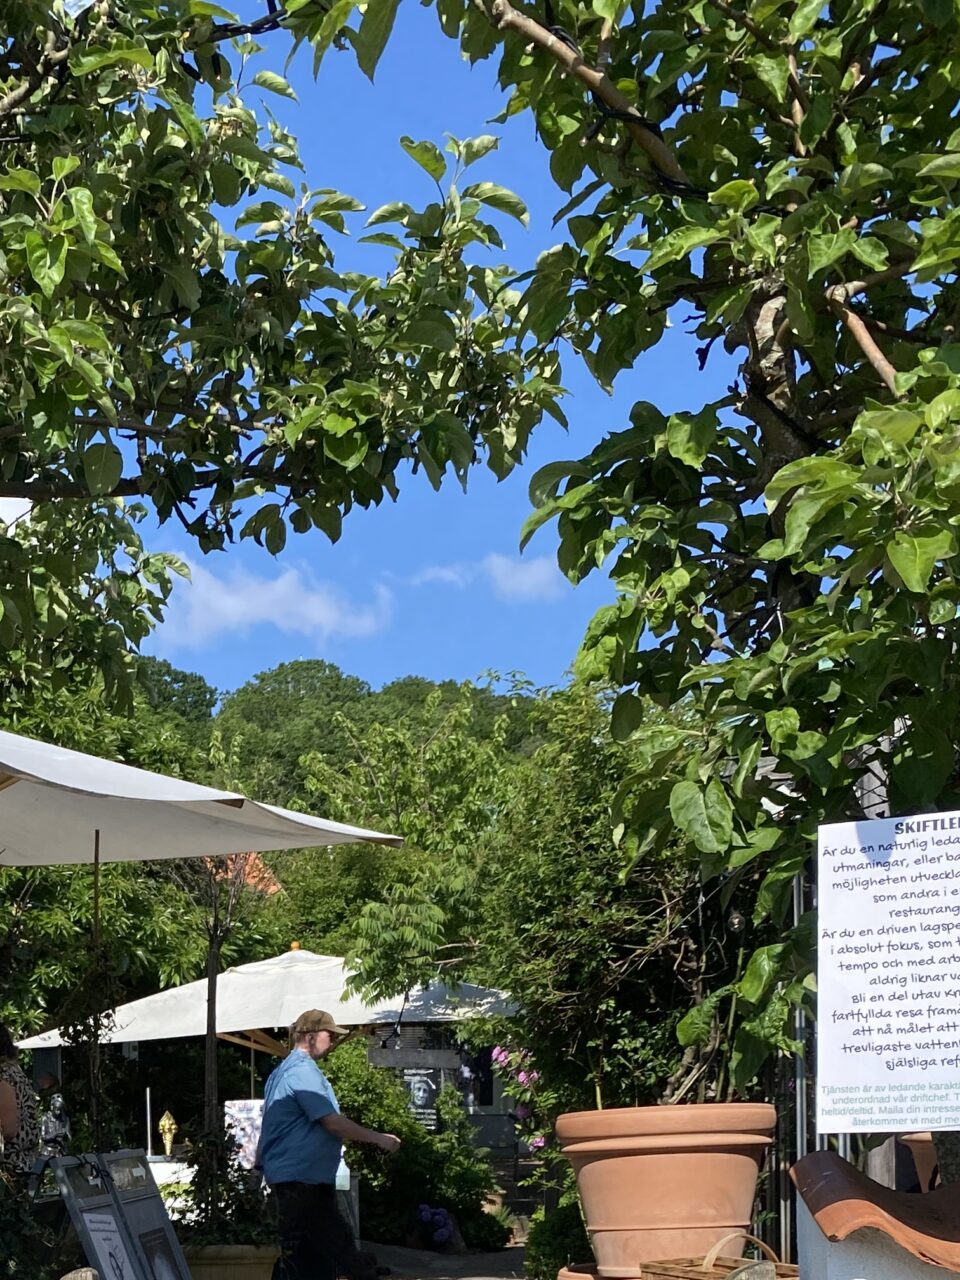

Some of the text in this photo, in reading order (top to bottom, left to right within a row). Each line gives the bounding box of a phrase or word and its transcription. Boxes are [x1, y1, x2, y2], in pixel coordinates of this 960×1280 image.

[822, 846, 837, 857] Är
[840, 845, 856, 855] du
[860, 845, 874, 854] en
[878, 838, 928, 851] naturlig
[832, 858, 910, 873] utmaningar,
[913, 854, 944, 865] eller
[832, 874, 907, 891] möjligheten
[873, 894, 897, 903] som
[900, 889, 940, 900] andra
[943, 886, 947, 897] i
[821, 928, 837, 939] Är
[839, 929, 855, 938] du
[858, 928, 874, 936] en
[877, 924, 917, 935] driven
[830, 945, 834, 955] i
[837, 943, 884, 954] absolut
[885, 940, 923, 954] fokus,
[927, 940, 953, 949] som
[837, 961, 878, 973] tempo
[882, 959, 903, 968] och
[907, 956, 936, 966] med
[869, 976, 907, 987] aldrig
[911, 973, 948, 983] liknar
[851, 993, 866, 1004] Bli
[869, 993, 885, 1002] en
[888, 990, 908, 1001] del
[911, 990, 941, 1000] utav
[831, 1009, 893, 1023] fartfyllda
[895, 1008, 923, 1018] resa
[852, 1021, 960, 1036] att nå målet att
[841, 1038, 960, 1055] trevligaste vatten
[885, 1057, 937, 1070] själsliga
[888, 1082, 926, 1092] ledande
[832, 1094, 890, 1105] underordnad
[893, 1094, 908, 1103] vår
[878, 1106, 904, 1114] Maila
[907, 1105, 920, 1113] din
[851, 1117, 908, 1126] återkommer
[910, 1116, 919, 1125] vi
[920, 1115, 942, 1124] med
